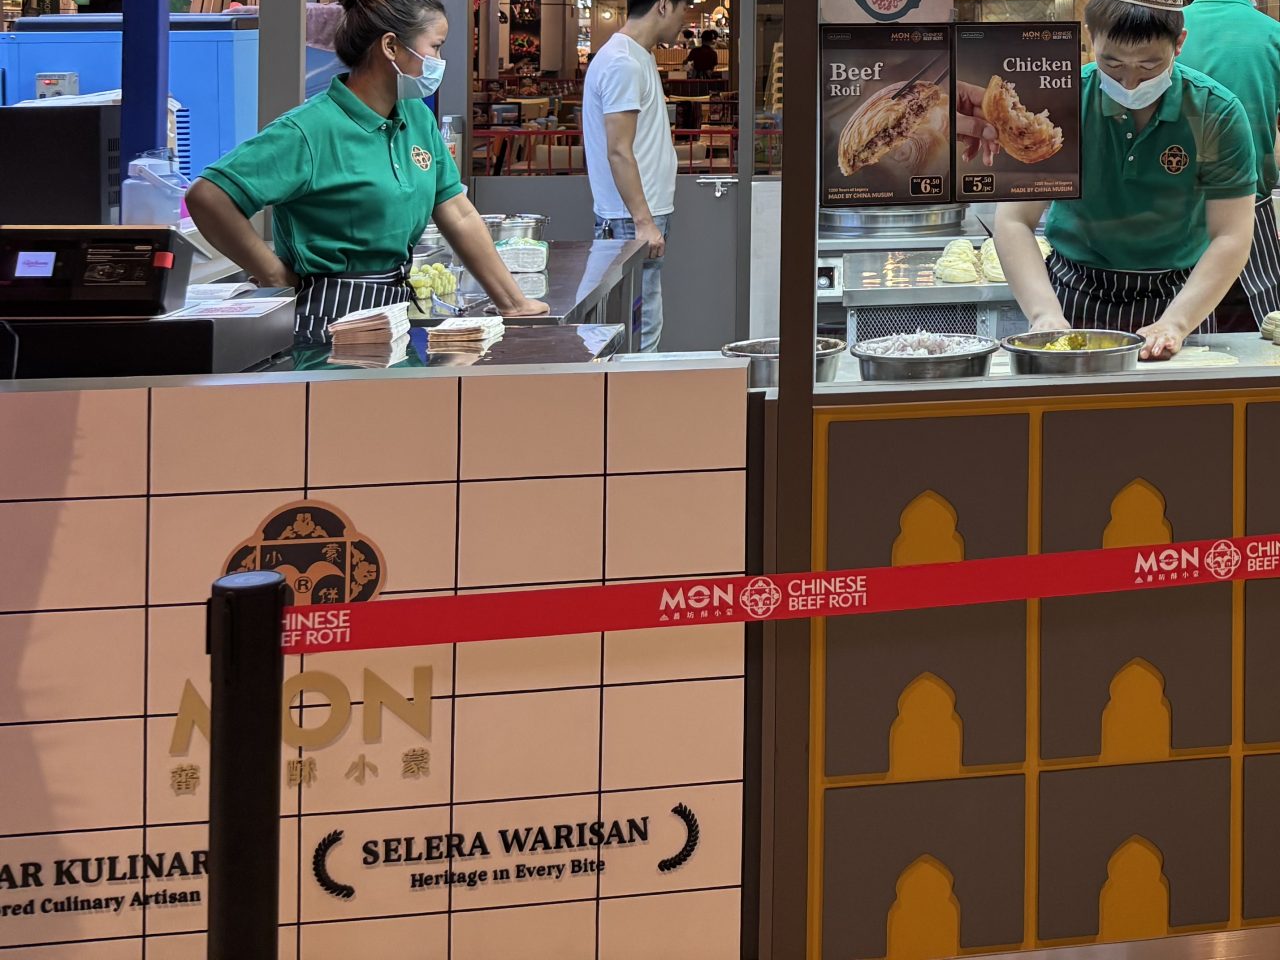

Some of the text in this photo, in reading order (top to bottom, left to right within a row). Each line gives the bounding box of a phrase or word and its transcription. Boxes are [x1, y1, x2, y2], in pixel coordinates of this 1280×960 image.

[830, 62, 884, 81] Beef
[1003, 57, 1072, 73] Chicken
[830, 84, 861, 97] Roti
[1039, 75, 1072, 89] Roti
[1134, 547, 1199, 573] MON
[1247, 556, 1280, 572] BEEF
[660, 576, 867, 610] MON CHINESE
[788, 592, 867, 611] BEEF ROTI
[282, 610, 351, 630] HINESE
[306, 628, 351, 645] ROTI
[361, 816, 650, 866] SELERA WARISAN
[410, 857, 606, 889] Heritage in Every Bite
[40, 895, 125, 914] Culinary
[130, 889, 201, 908] Artisan
